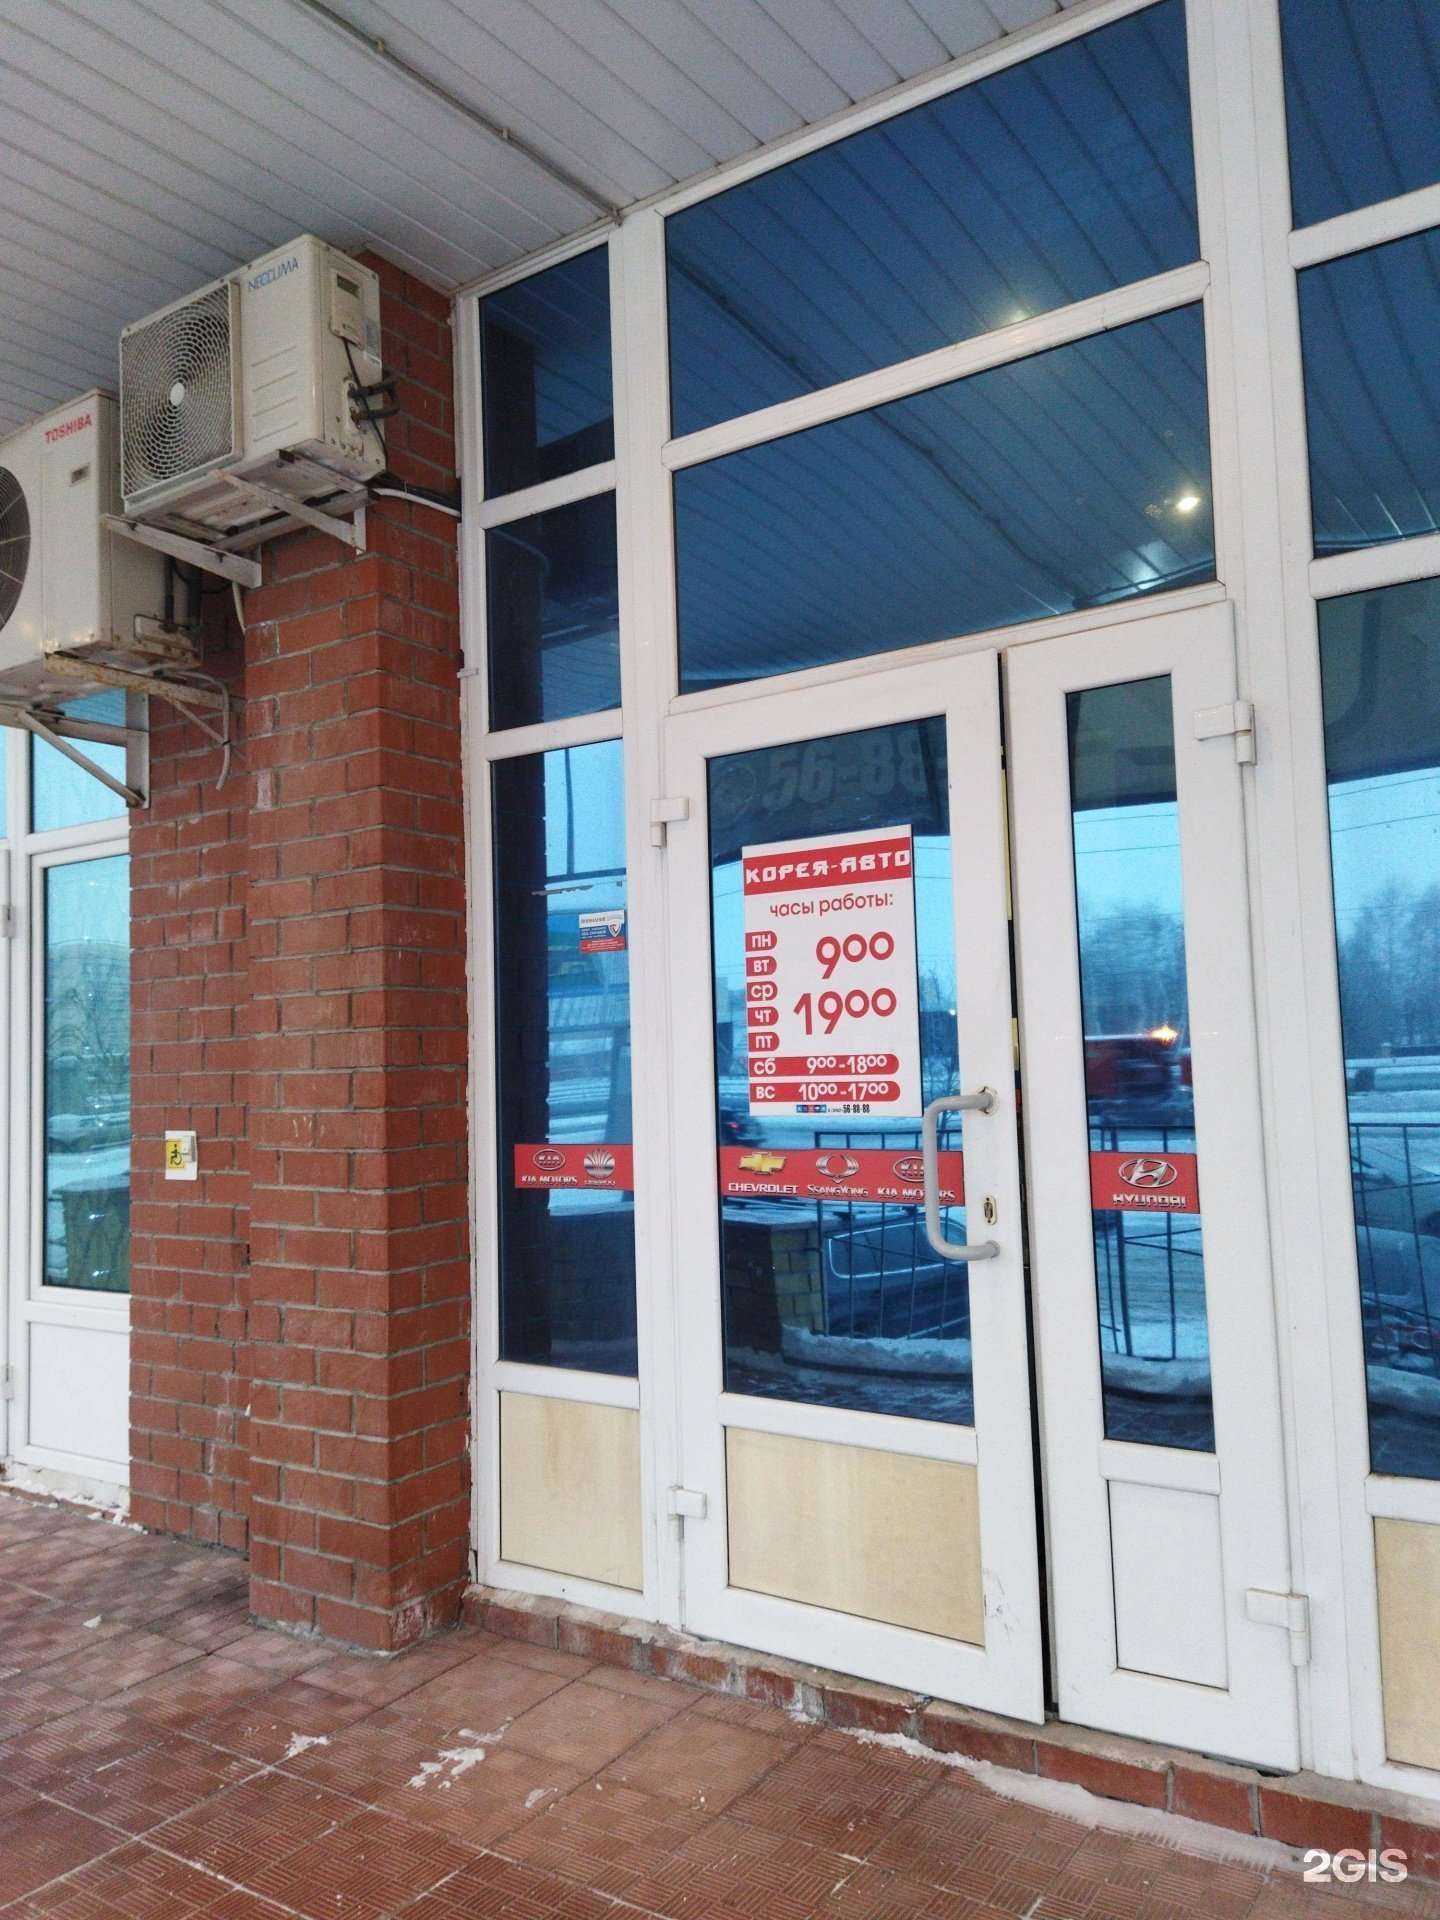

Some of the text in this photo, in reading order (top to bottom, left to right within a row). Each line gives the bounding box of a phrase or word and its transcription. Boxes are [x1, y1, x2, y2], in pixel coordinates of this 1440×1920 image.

[248, 256, 299, 291] NEOCLIMA
[45, 413, 92, 445] TOSHIBA
[745, 850, 911, 884] КОРЕЯ-АВТО
[769, 893, 894, 917] часы работы:
[520, 1174, 537, 1184] KIA
[727, 1182, 799, 1195] CHEVROLET
[876, 1186, 956, 1200] KIA MOTRS
[1112, 1193, 1186, 1206] HYUNDAI
